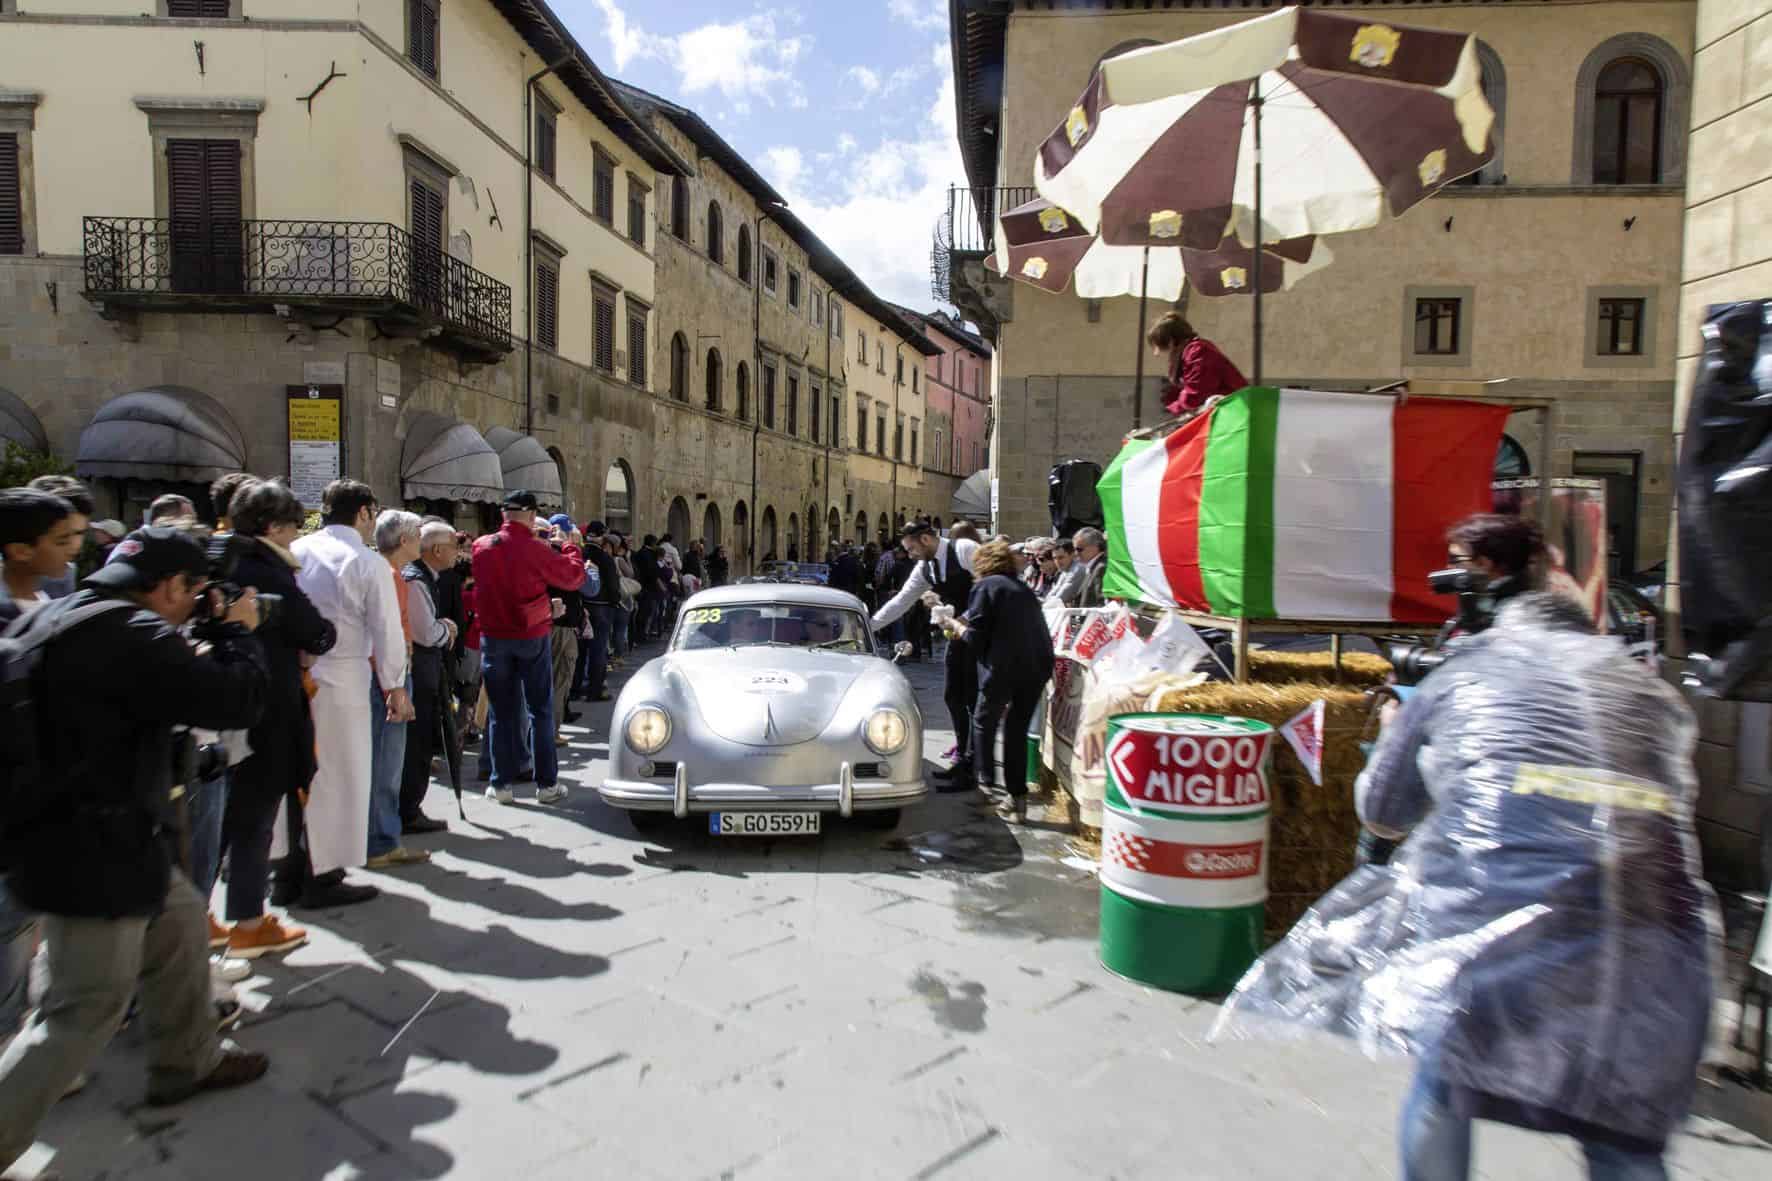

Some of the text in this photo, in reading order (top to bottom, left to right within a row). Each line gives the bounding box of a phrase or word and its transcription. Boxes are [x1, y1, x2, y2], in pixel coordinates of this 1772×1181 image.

[684, 608, 720, 624] 223
[1154, 735, 1257, 769] 1000
[1144, 769, 1260, 804] MIGLIA
[722, 815, 733, 832] S
